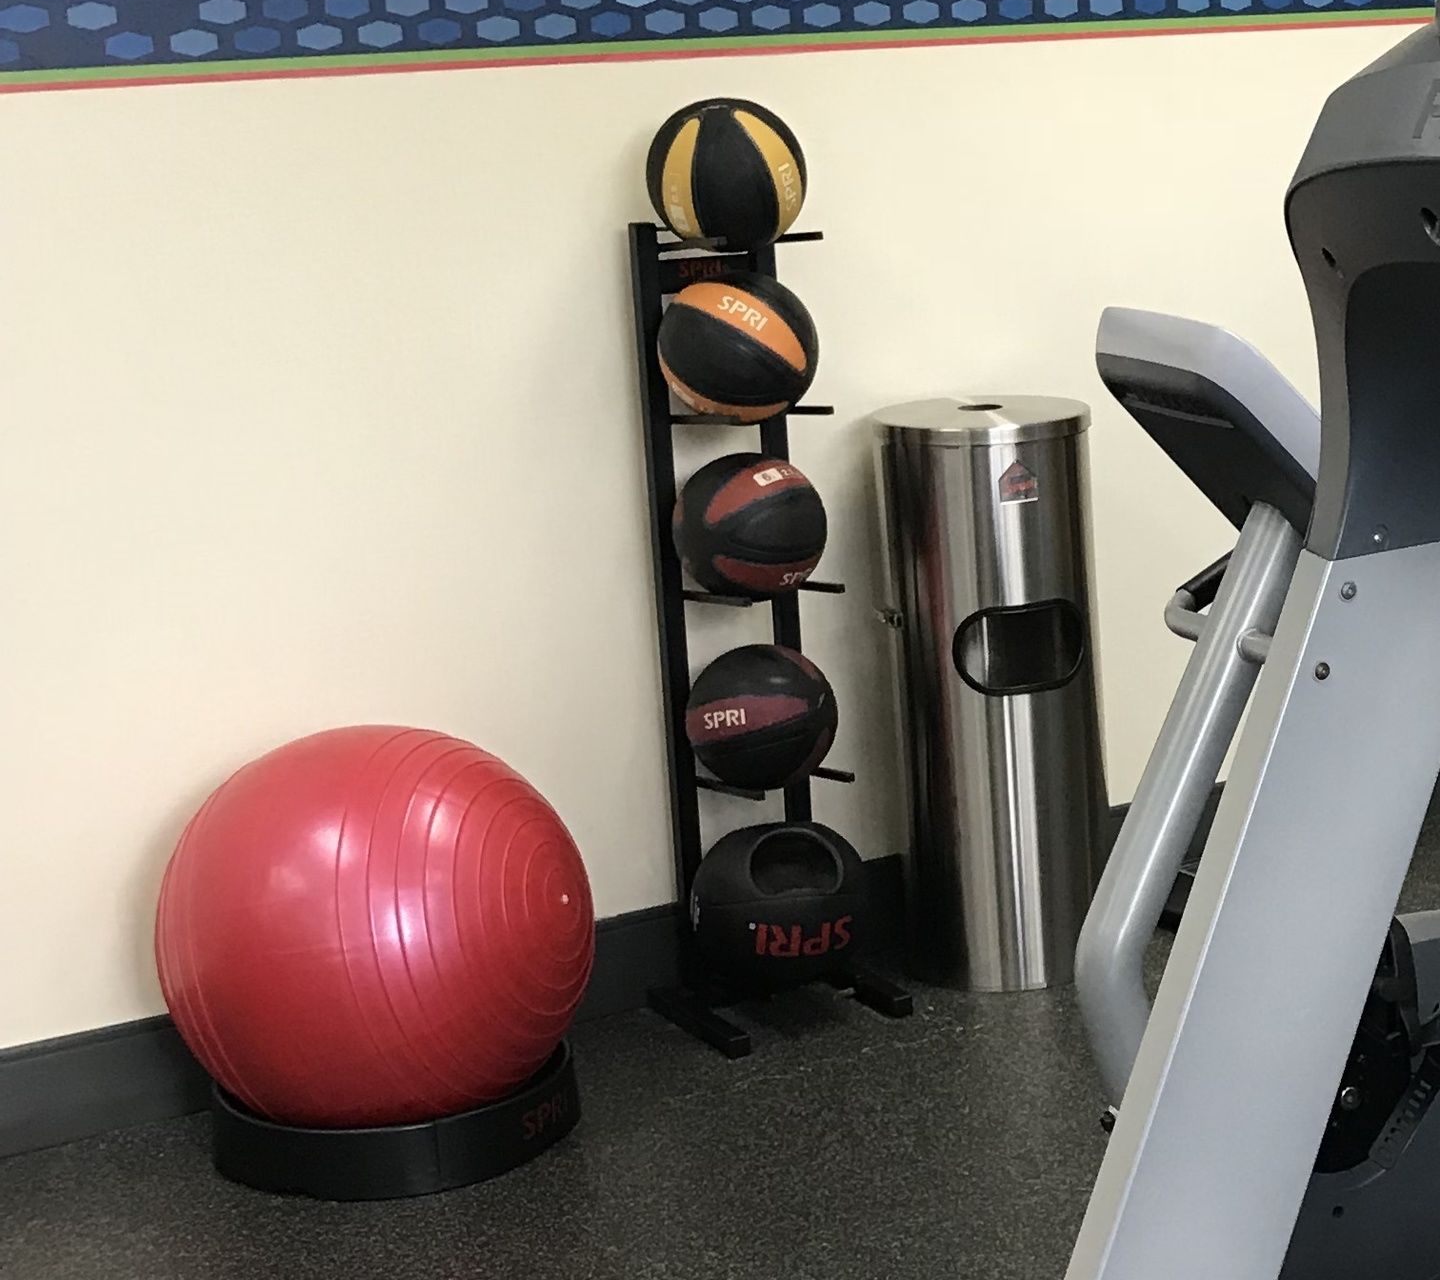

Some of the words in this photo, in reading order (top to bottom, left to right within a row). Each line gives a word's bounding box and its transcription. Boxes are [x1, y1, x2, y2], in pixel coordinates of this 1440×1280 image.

[777, 162, 797, 211] SPRI
[716, 295, 768, 331] SPRI
[704, 708, 747, 730] SPRI
[755, 915, 853, 958] SPRI
